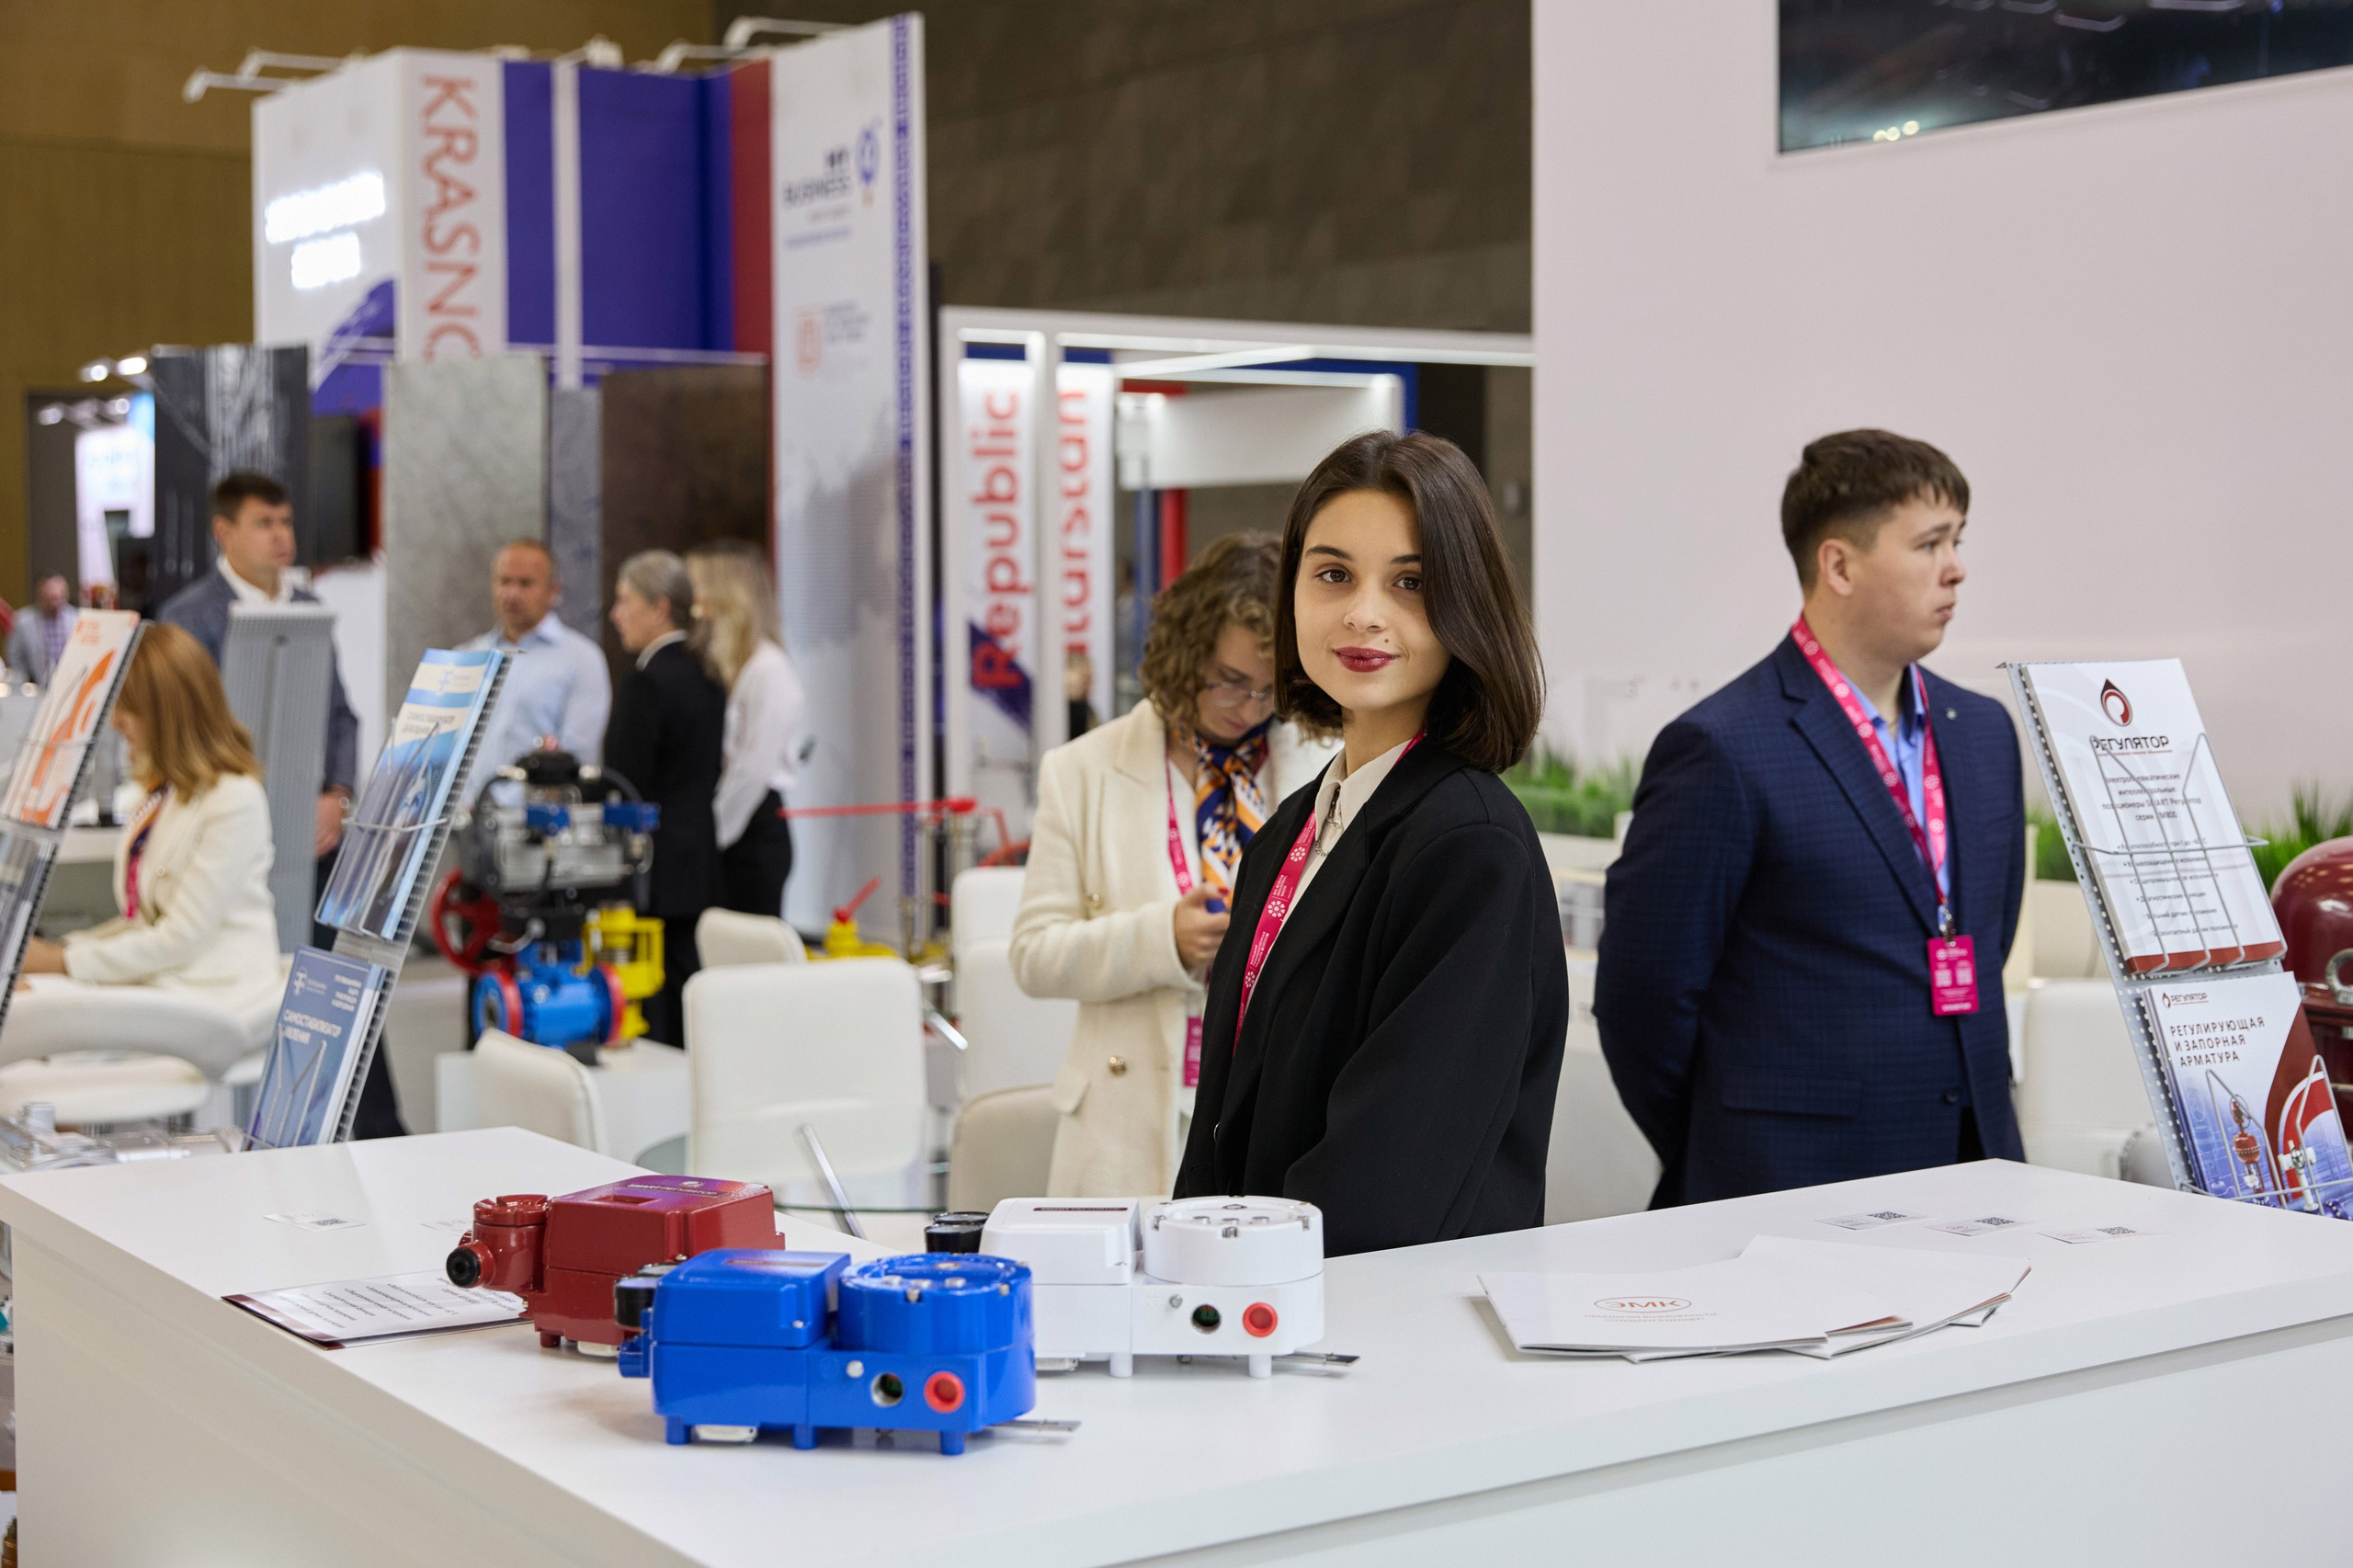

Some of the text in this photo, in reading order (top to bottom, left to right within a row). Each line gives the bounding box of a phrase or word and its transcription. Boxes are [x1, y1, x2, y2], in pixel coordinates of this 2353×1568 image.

[971, 389, 1034, 688] Republic
[2169, 1017, 2265, 1037] РЕГУЛИРУЮЩАЯ
[2174, 1034, 2246, 1051] И ЗАПОРНАЯ
[2180, 1051, 2240, 1067] АРМАТУРА
[1605, 1300, 1681, 1309] ЭМК
